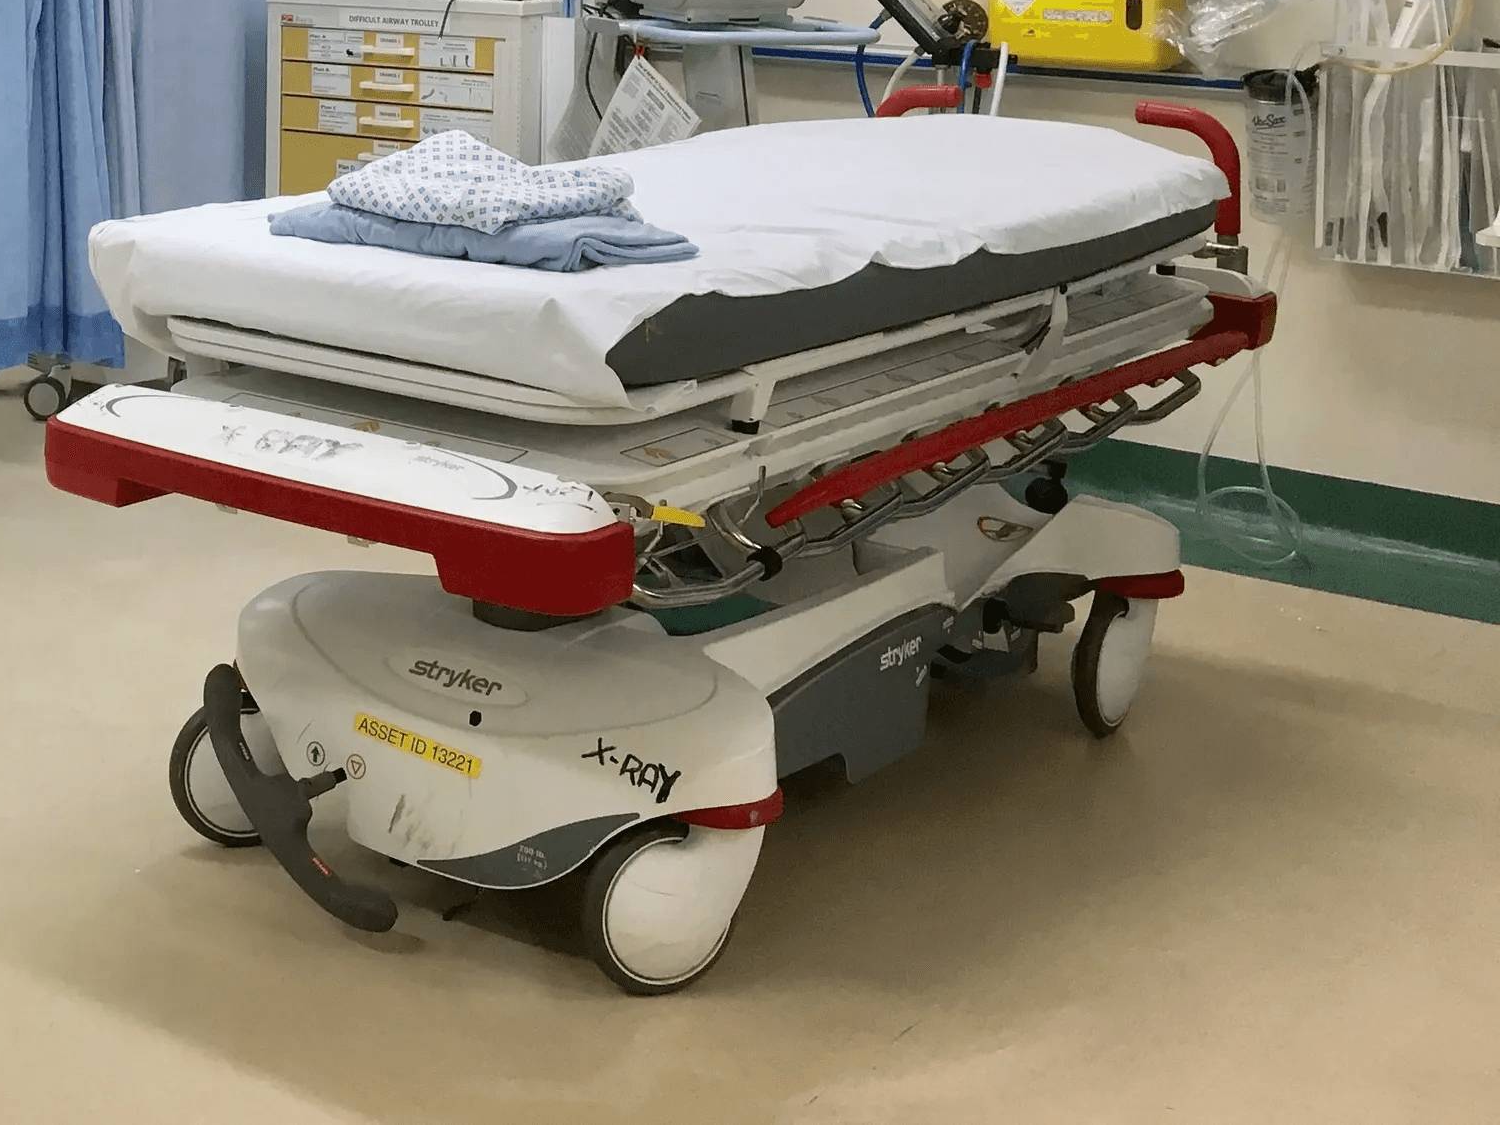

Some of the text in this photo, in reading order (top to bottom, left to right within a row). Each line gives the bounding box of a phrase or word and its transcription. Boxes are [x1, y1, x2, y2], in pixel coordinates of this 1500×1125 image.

[349, 15, 439, 27] DIFFICULT AIRWAY TROLLEY
[880, 636, 922, 671] stryker
[408, 659, 502, 696] stryker
[358, 717, 473, 774] ASSET ID 13221
[581, 737, 682, 804] X-RAY
